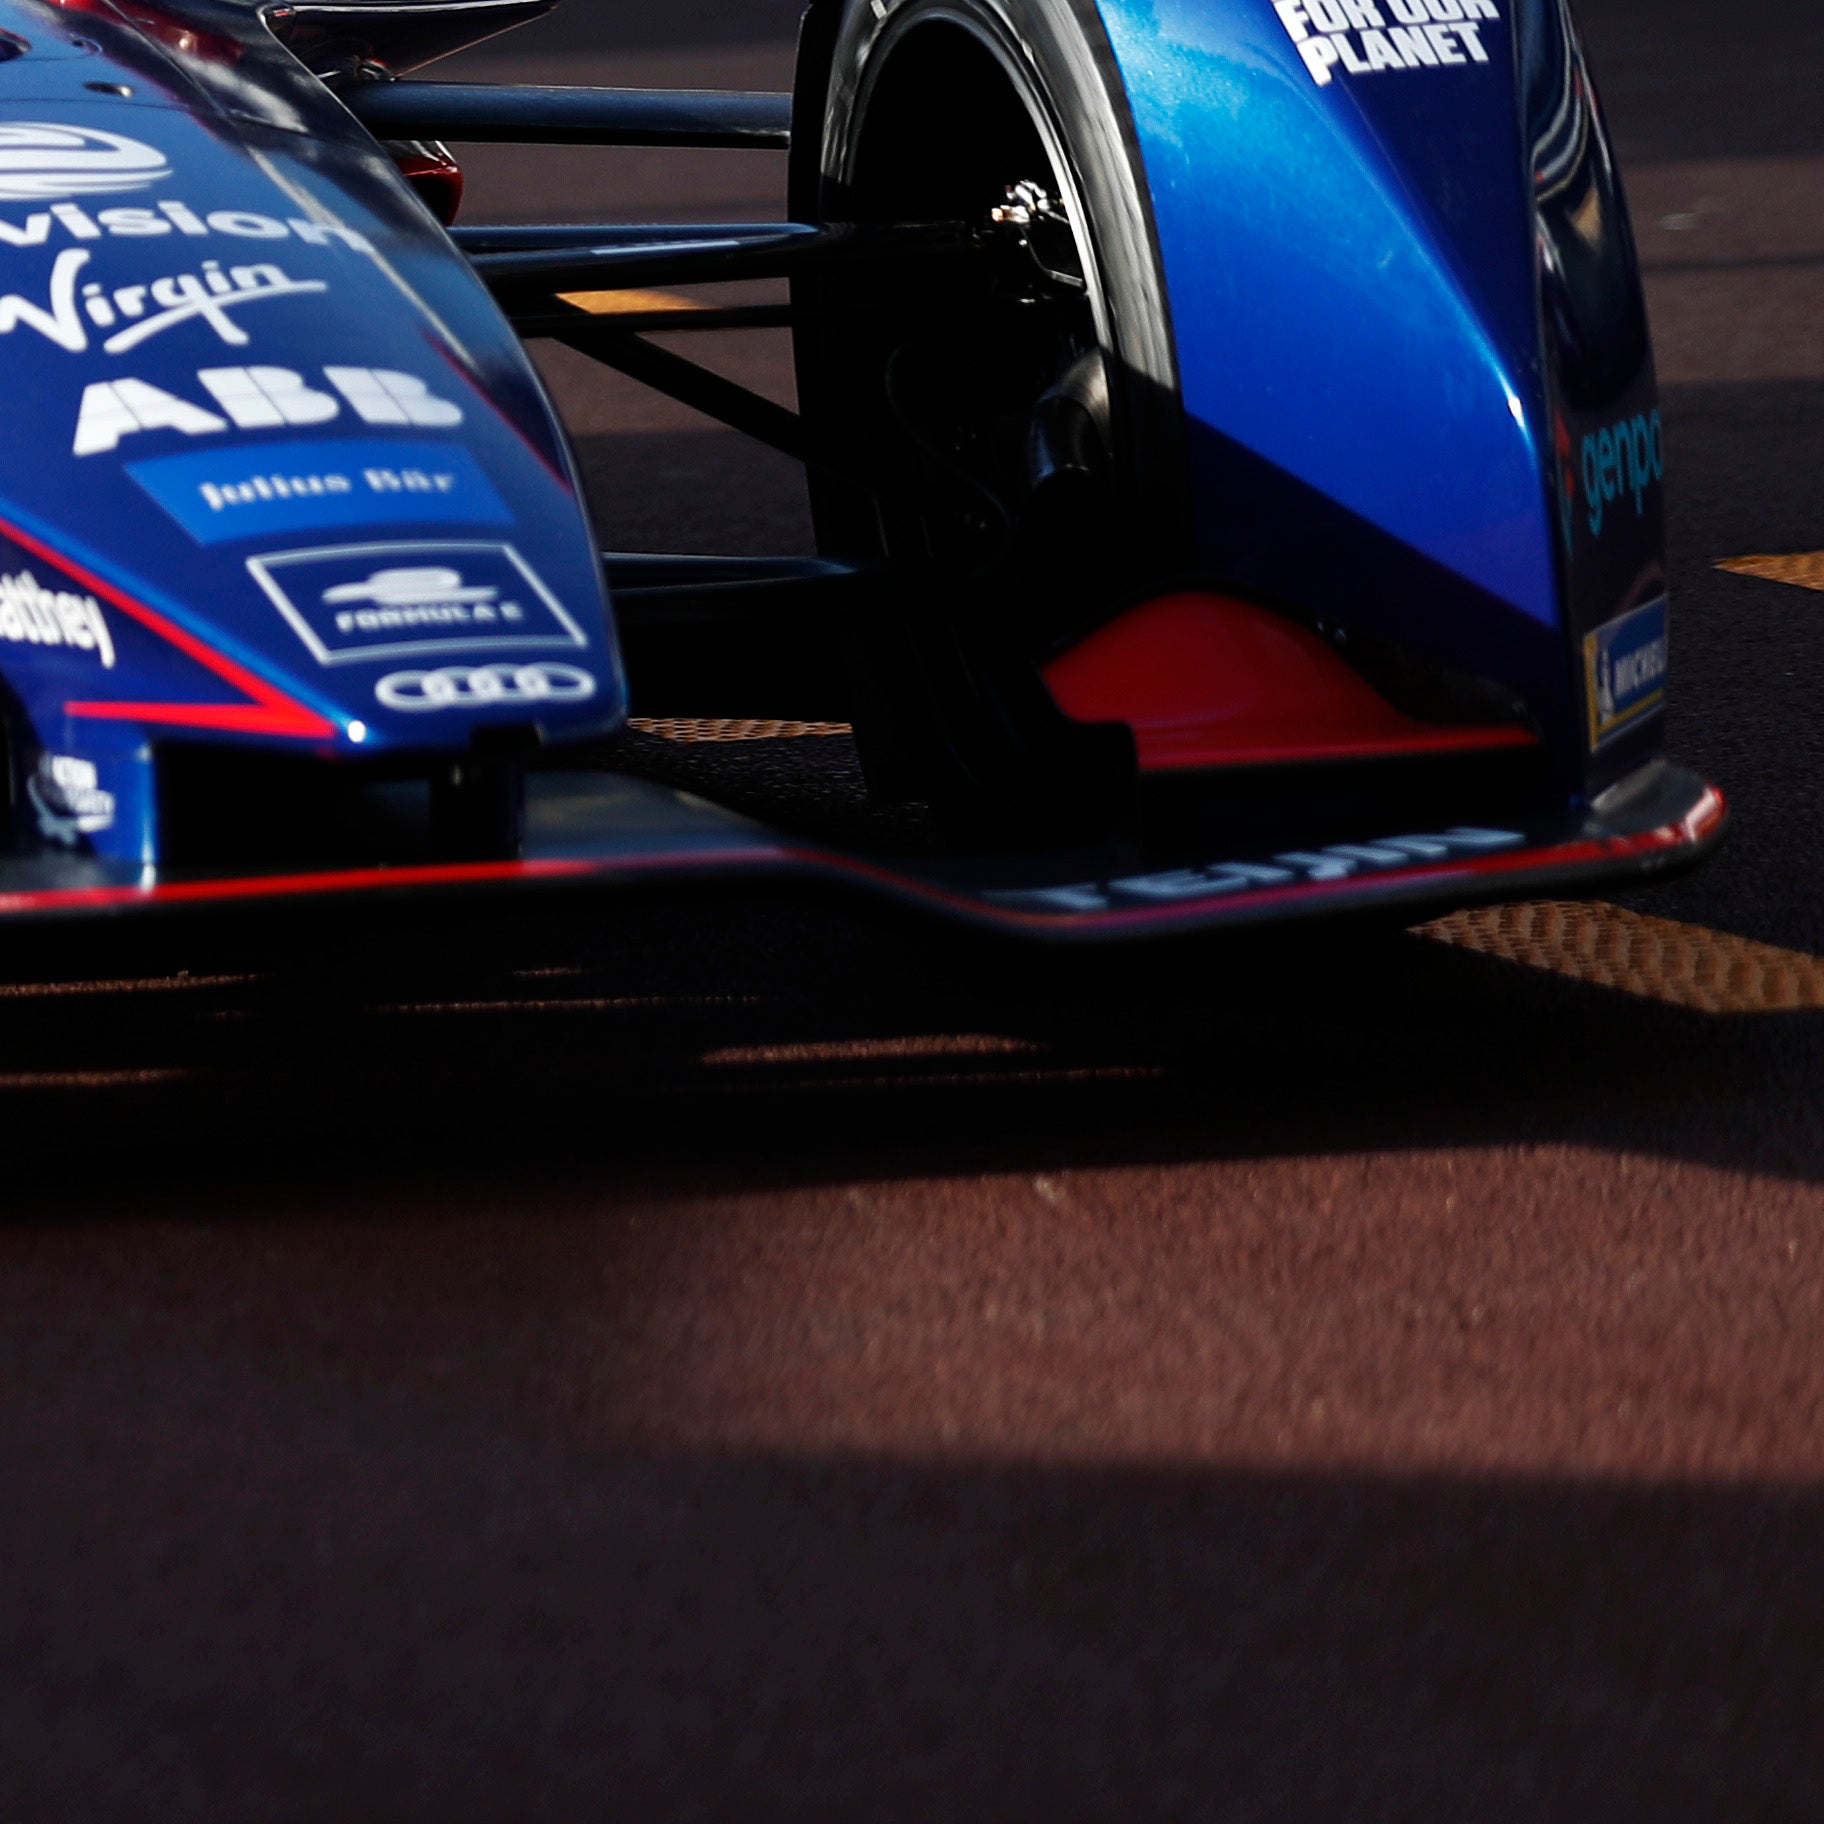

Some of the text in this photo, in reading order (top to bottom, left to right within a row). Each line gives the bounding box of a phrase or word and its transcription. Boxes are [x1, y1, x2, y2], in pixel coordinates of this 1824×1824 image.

[1296, 21, 1489, 87] PLANET
[73, 366, 463, 456] ABB
[200, 474, 352, 512] Julius
[336, 600, 525, 634] FORMULA E
